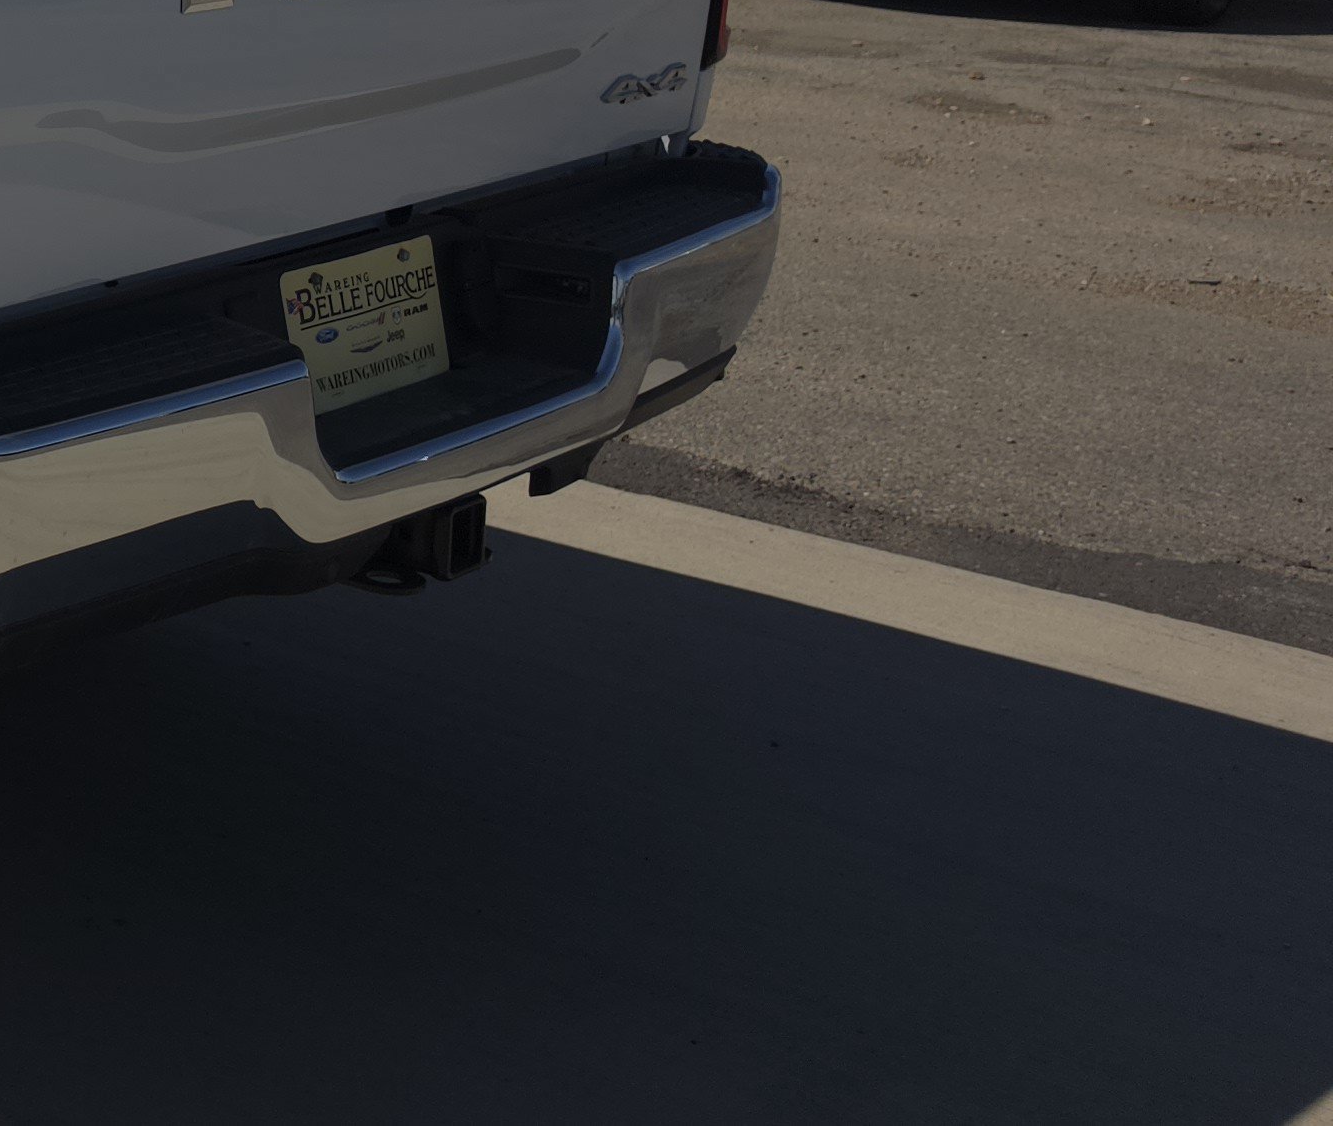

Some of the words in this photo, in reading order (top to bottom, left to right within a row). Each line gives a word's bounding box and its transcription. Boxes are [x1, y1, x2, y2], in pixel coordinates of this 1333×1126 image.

[294, 287, 364, 326] BELLE
[364, 266, 436, 308] FOURCHE
[312, 271, 370, 296] WAREING
[403, 303, 429, 317] RAM
[386, 328, 406, 343] Jeep
[315, 343, 437, 393] WAREINGMOTORS.COM
